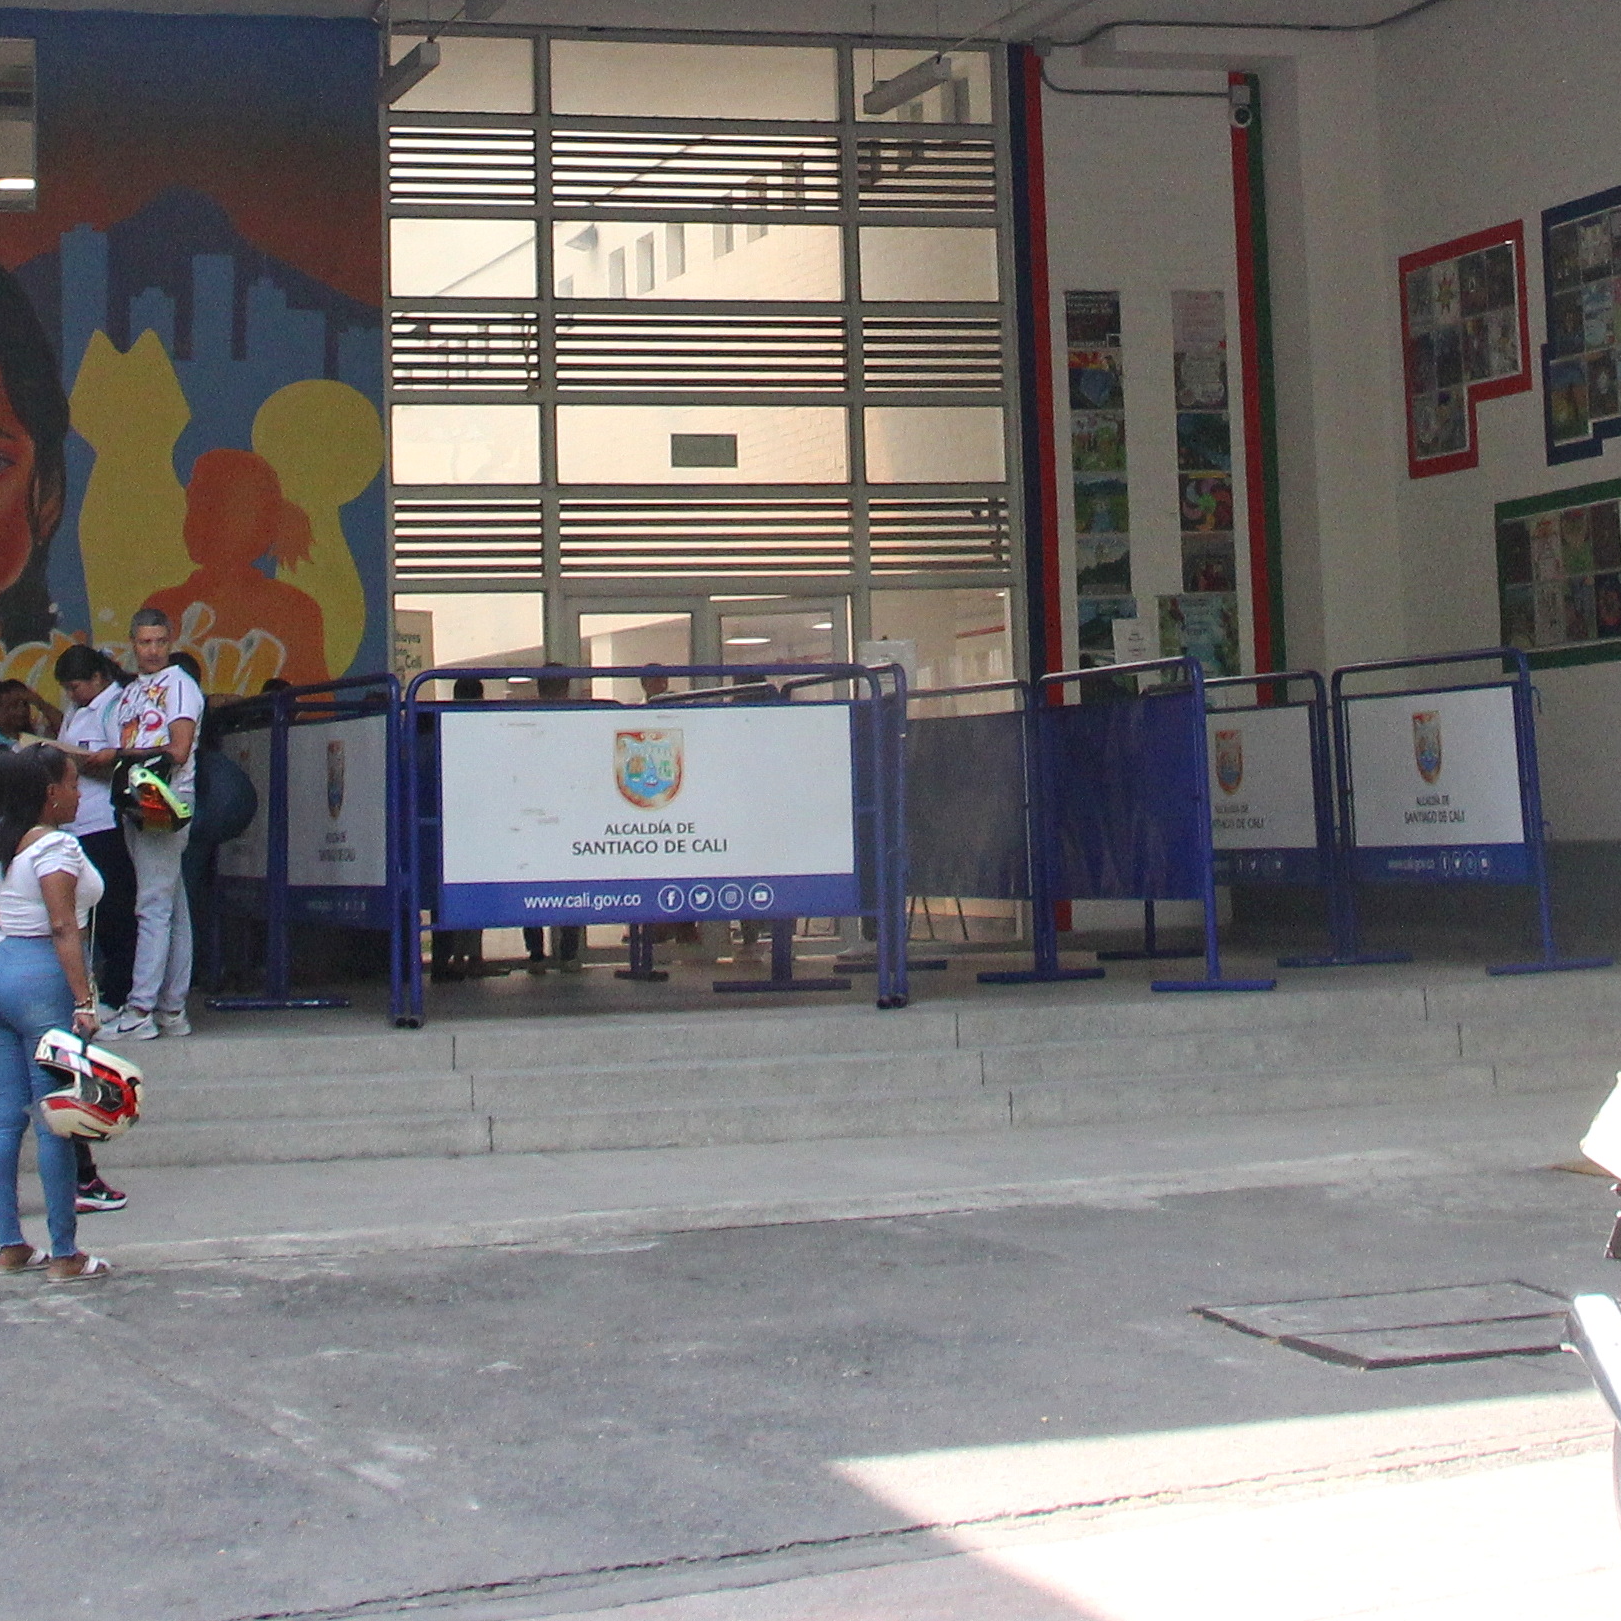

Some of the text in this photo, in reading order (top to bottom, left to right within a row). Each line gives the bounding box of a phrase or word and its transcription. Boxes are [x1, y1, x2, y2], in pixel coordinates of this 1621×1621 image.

[604, 818, 695, 836] ALCALDÍA DE
[571, 838, 728, 856] SANTIAGO DE CALI
[524, 891, 642, 911] www.cali.gov.co
